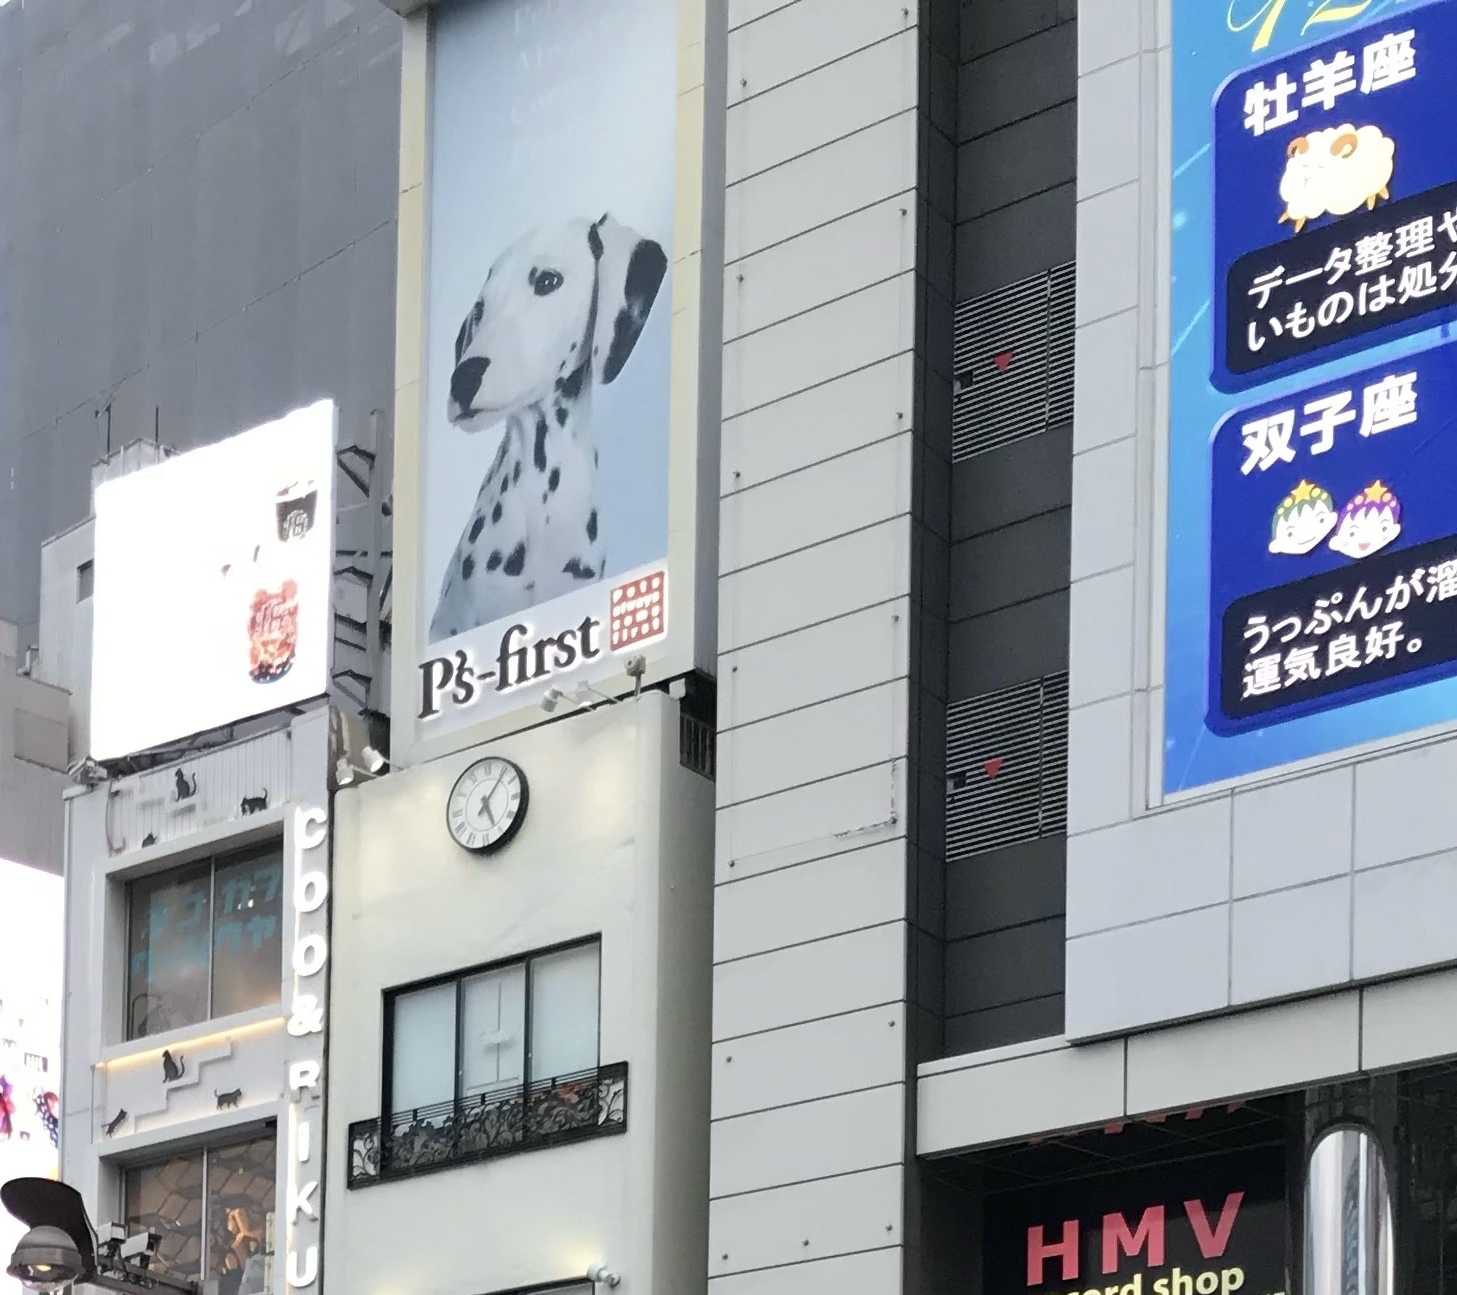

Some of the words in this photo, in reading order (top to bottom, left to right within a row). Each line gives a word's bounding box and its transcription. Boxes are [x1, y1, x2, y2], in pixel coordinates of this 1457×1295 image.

[1243, 30, 1417, 138] 牡羊座
[1241, 372, 1418, 476] 双子座
[1243, 559, 1457, 654] うっぷんが溜
[418, 615, 602, 721] P's-first
[1241, 621, 1423, 701] 運気良好。
[288, 993, 324, 1037] &
[1026, 1191, 1245, 1287] HMV
